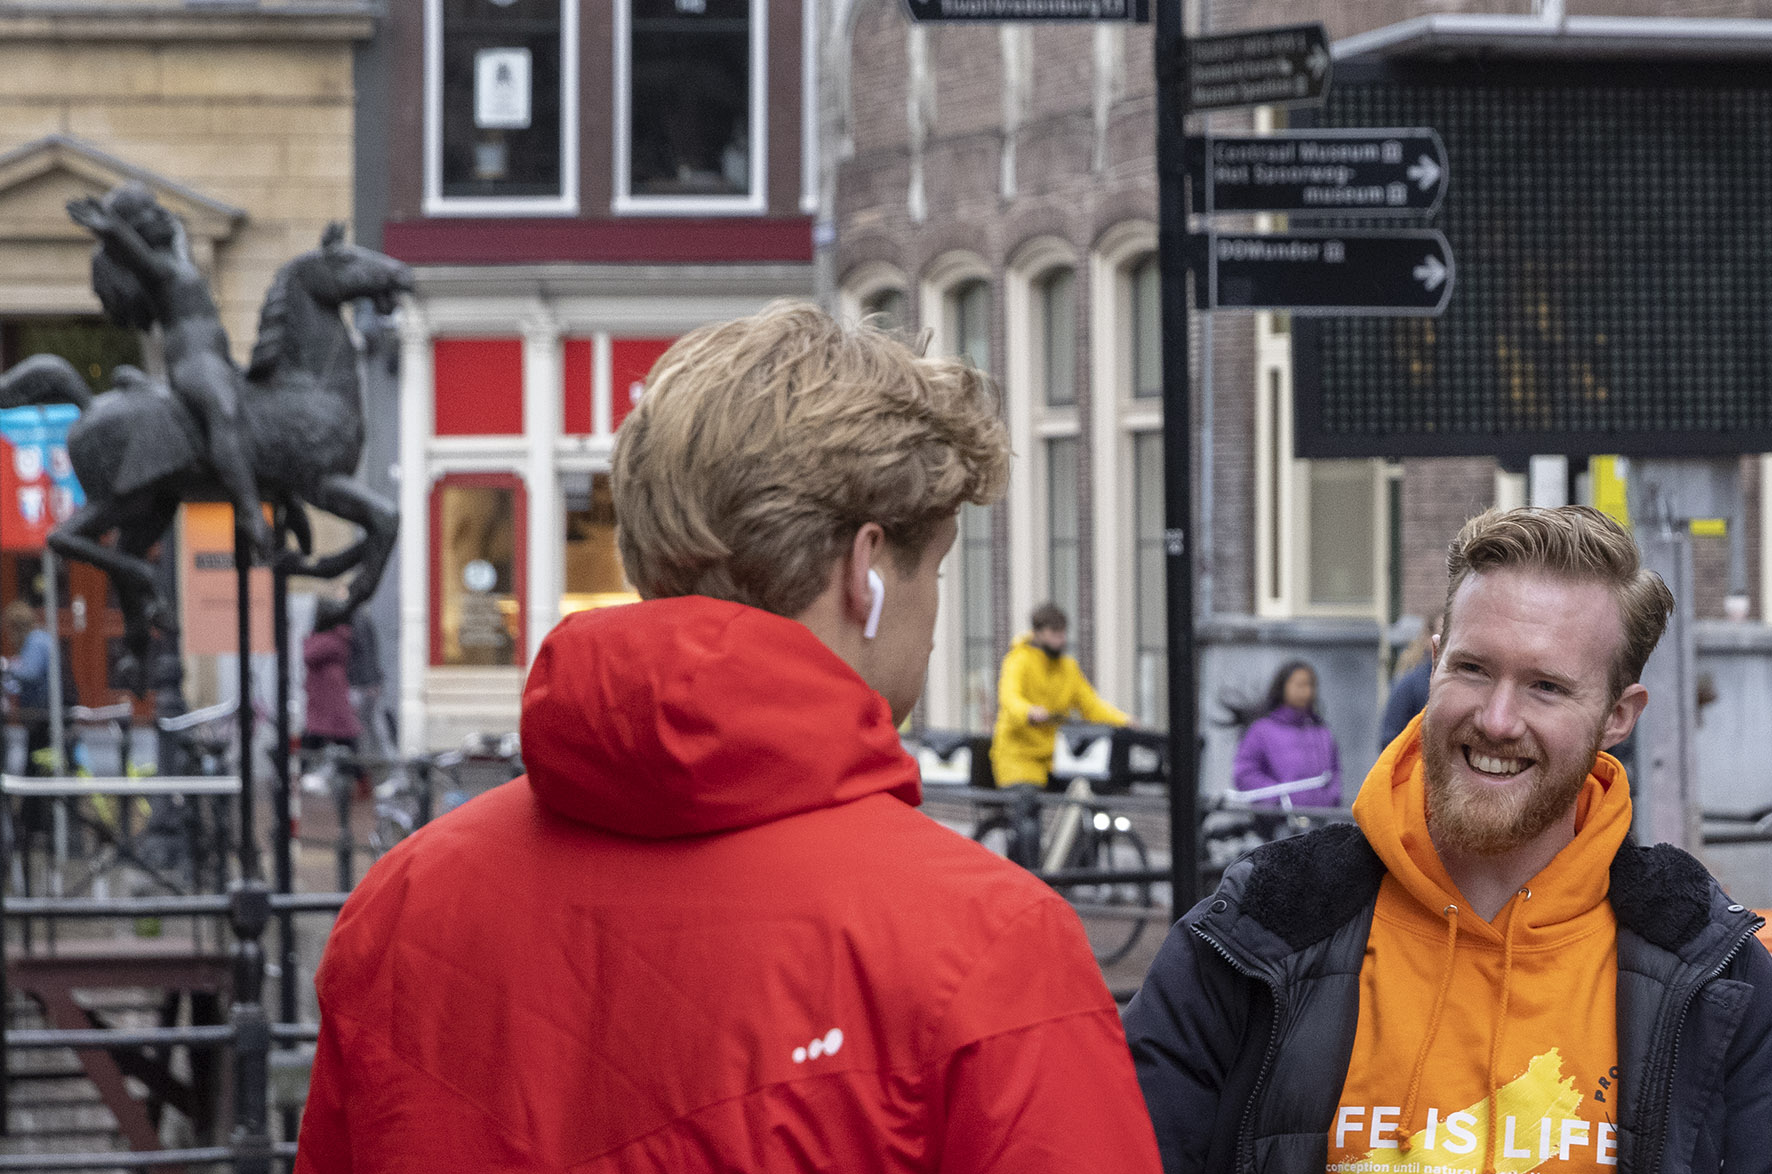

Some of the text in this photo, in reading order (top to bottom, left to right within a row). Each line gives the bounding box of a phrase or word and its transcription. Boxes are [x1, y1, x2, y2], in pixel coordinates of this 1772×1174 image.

[1299, 141, 1380, 163] Museum
[1303, 186, 1385, 204] museum
[1423, 1108, 1478, 1154] IS
[1503, 1115, 1618, 1165] LIFE
[1325, 1162, 1390, 1174] conception
[1393, 1162, 1420, 1173] until
